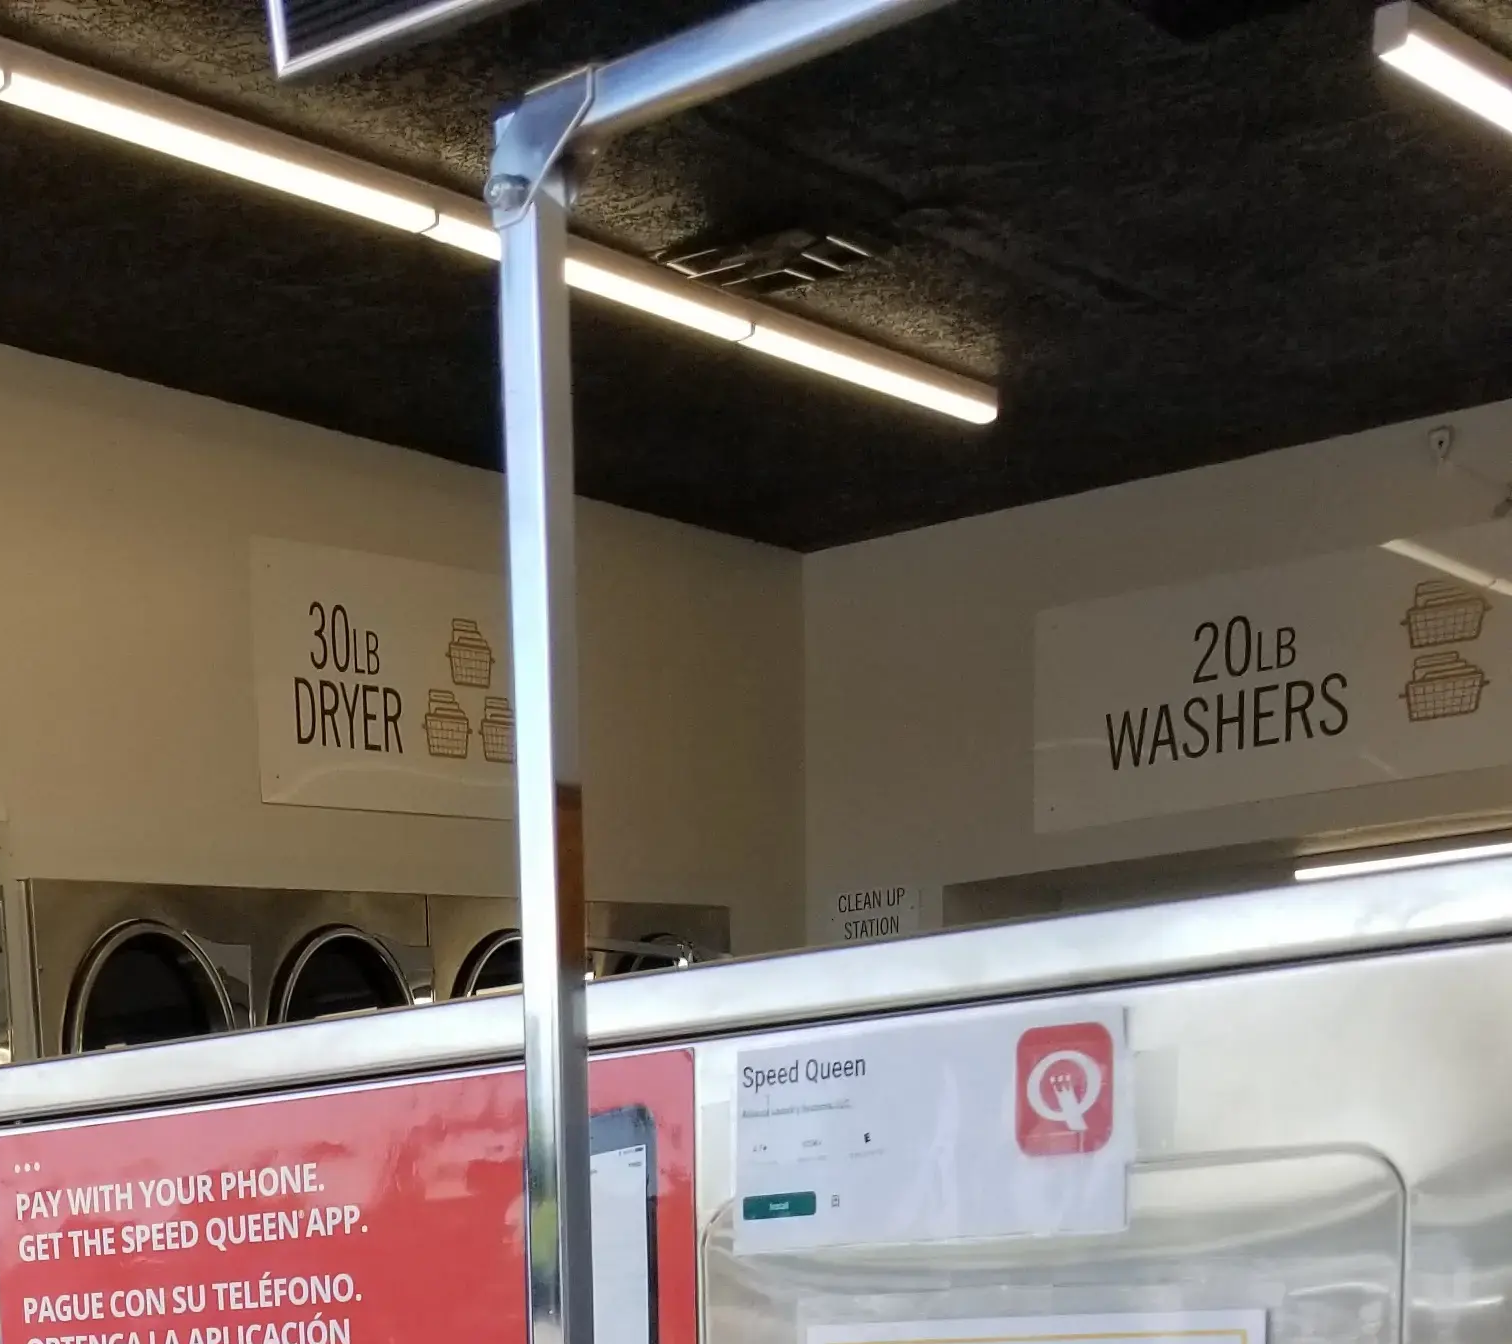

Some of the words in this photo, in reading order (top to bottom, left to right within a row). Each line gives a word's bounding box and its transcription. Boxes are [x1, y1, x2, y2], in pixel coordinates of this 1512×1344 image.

[308, 601, 380, 676] 30LB
[1193, 615, 1296, 683] 20LB
[294, 676, 404, 754] DRYER
[1105, 673, 1348, 771] WASHERS
[839, 891, 881, 912] CLEAN
[887, 887, 904, 906] UP
[845, 916, 899, 939] STATION
[743, 1061, 800, 1094] Speed
[805, 1055, 866, 1085] Queen
[16, 1190, 63, 1221] PAY
[67, 1183, 132, 1215] WITH
[138, 1174, 215, 1208] YOUR
[221, 1162, 324, 1200] PHONE.
[18, 1233, 67, 1262] GET
[68, 1228, 116, 1258] THE
[121, 1221, 198, 1253] SPEED
[306, 1205, 368, 1237] APP.
[23, 1292, 104, 1323] PAGUE
[110, 1288, 165, 1317] CON
[172, 1285, 205, 1313] SU
[213, 1273, 362, 1311] TELÉFONO.
